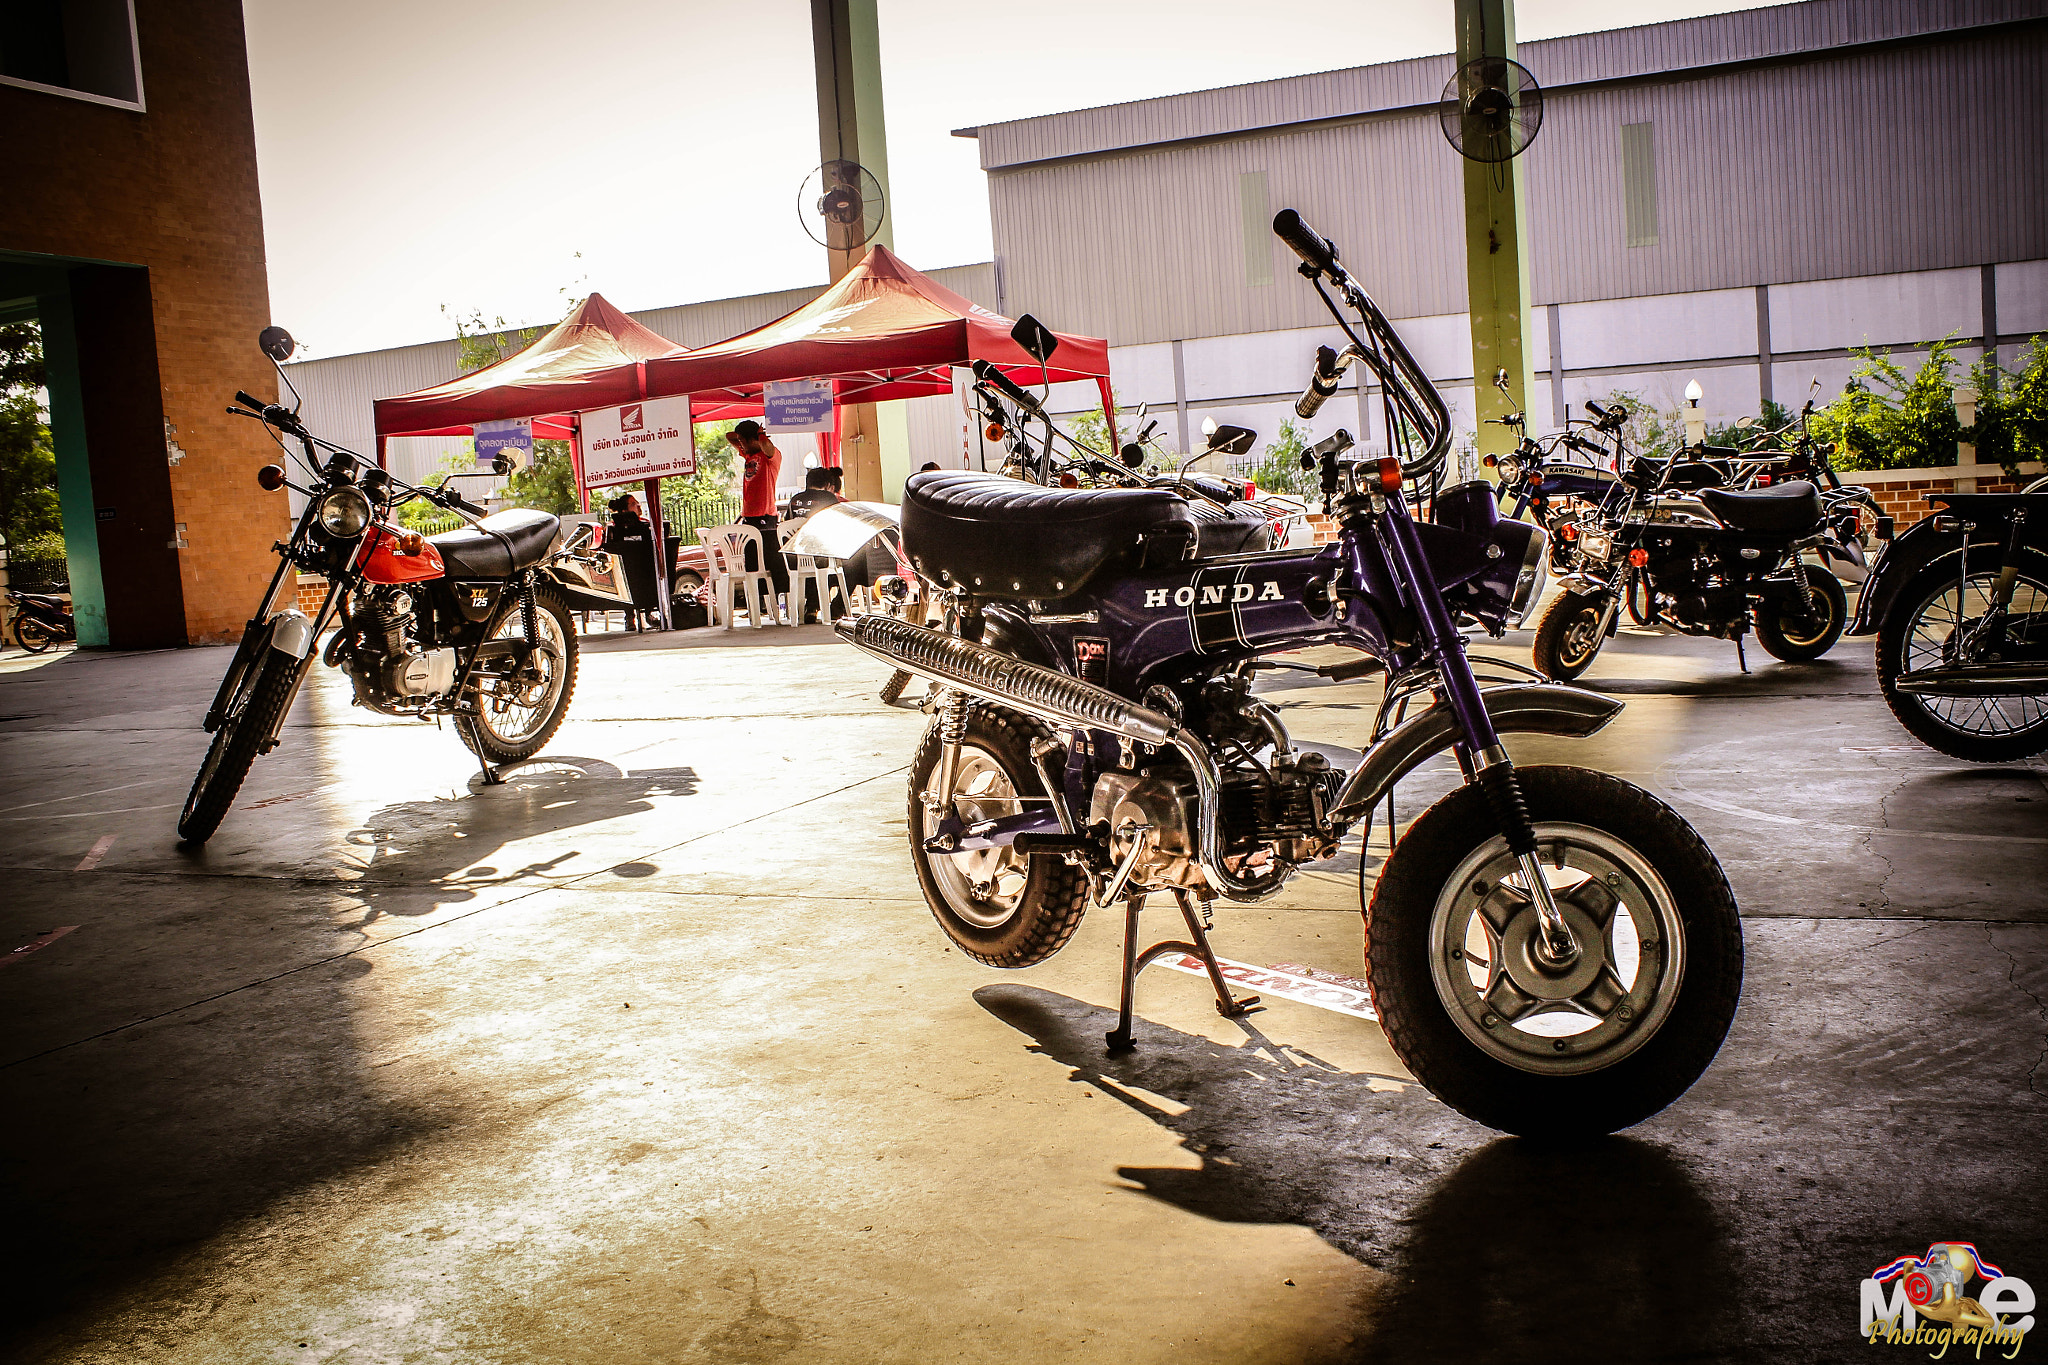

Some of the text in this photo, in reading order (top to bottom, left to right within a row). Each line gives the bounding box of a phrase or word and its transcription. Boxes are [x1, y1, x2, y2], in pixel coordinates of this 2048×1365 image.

[479, 436, 528, 450] จุดลงทะเบียน
[592, 427, 679, 451] บริษัท เอ.พี.ฮอนด้า จำกัด
[622, 447, 646, 461] ร่วมกับ
[586, 471, 604, 483] บริษัท
[672, 458, 692, 469] จำกัด
[1549, 467, 1585, 476] KAWASAKI
[470, 588, 485, 598] XL
[1143, 581, 1285, 608] HONDA
[472, 597, 489, 608] 125
[1077, 641, 1105, 660] Dax
